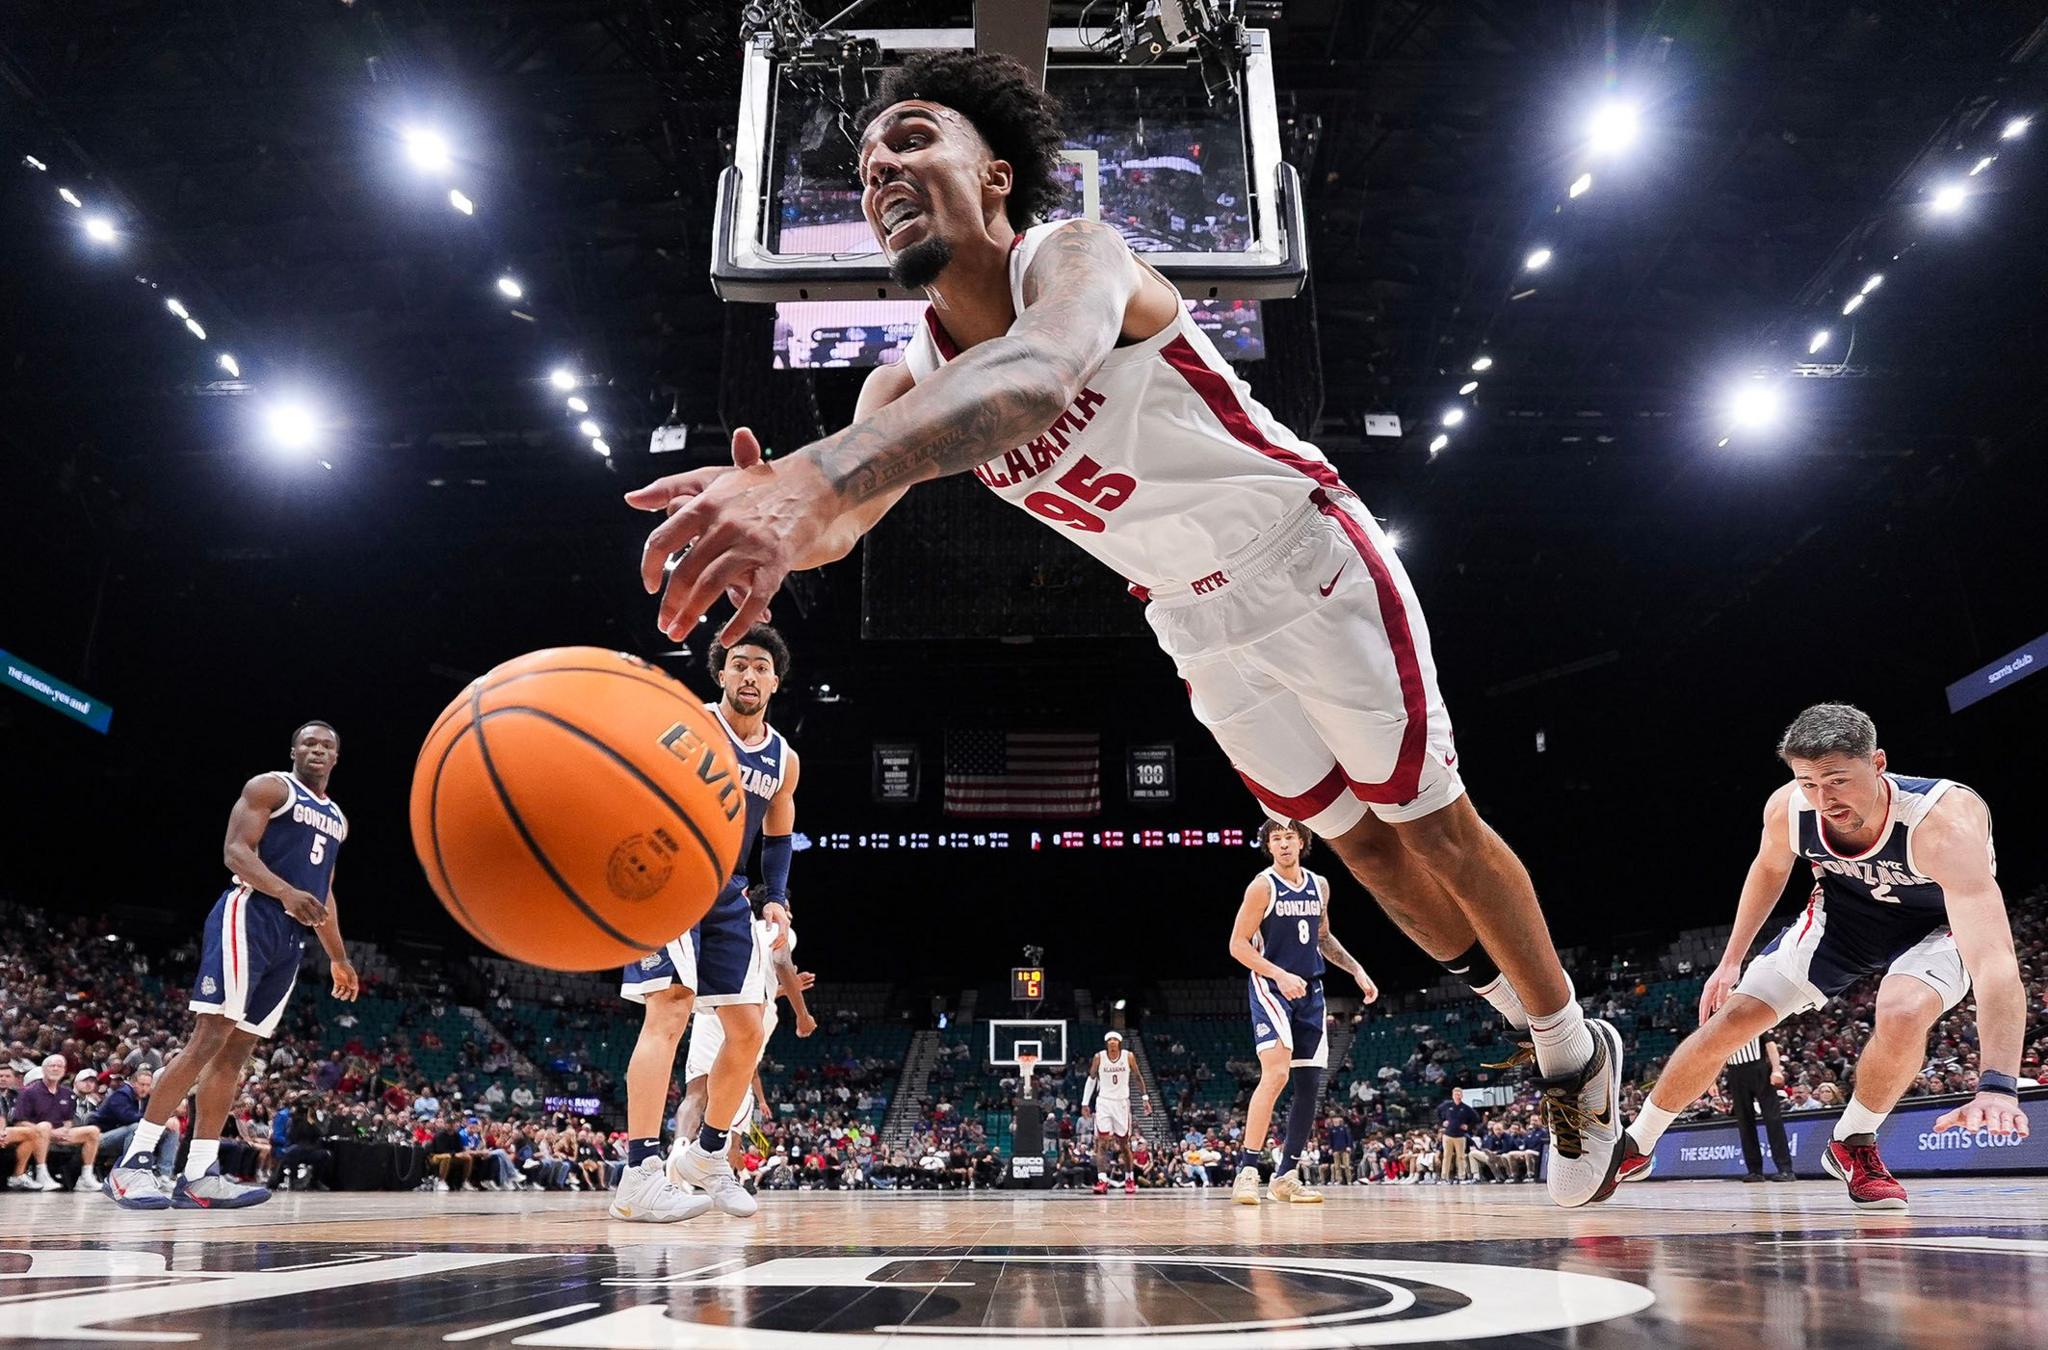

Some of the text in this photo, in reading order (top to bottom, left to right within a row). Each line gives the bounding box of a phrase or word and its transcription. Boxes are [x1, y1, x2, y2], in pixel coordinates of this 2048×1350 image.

[1023, 454, 1137, 534] 95
[1190, 570, 1230, 596] RTR
[1136, 764, 1163, 785] 100
[310, 833, 327, 865] 5
[1821, 860, 1934, 886] ONZAGA
[1870, 883, 1901, 904] 2
[1298, 919, 1310, 945] 8
[1028, 981, 1038, 997] 6
[1112, 1074, 1118, 1085] 0
[1918, 1127, 1972, 1151] sam's
[1680, 1147, 1697, 1161] THE
[1697, 1145, 1735, 1161] SEASON
